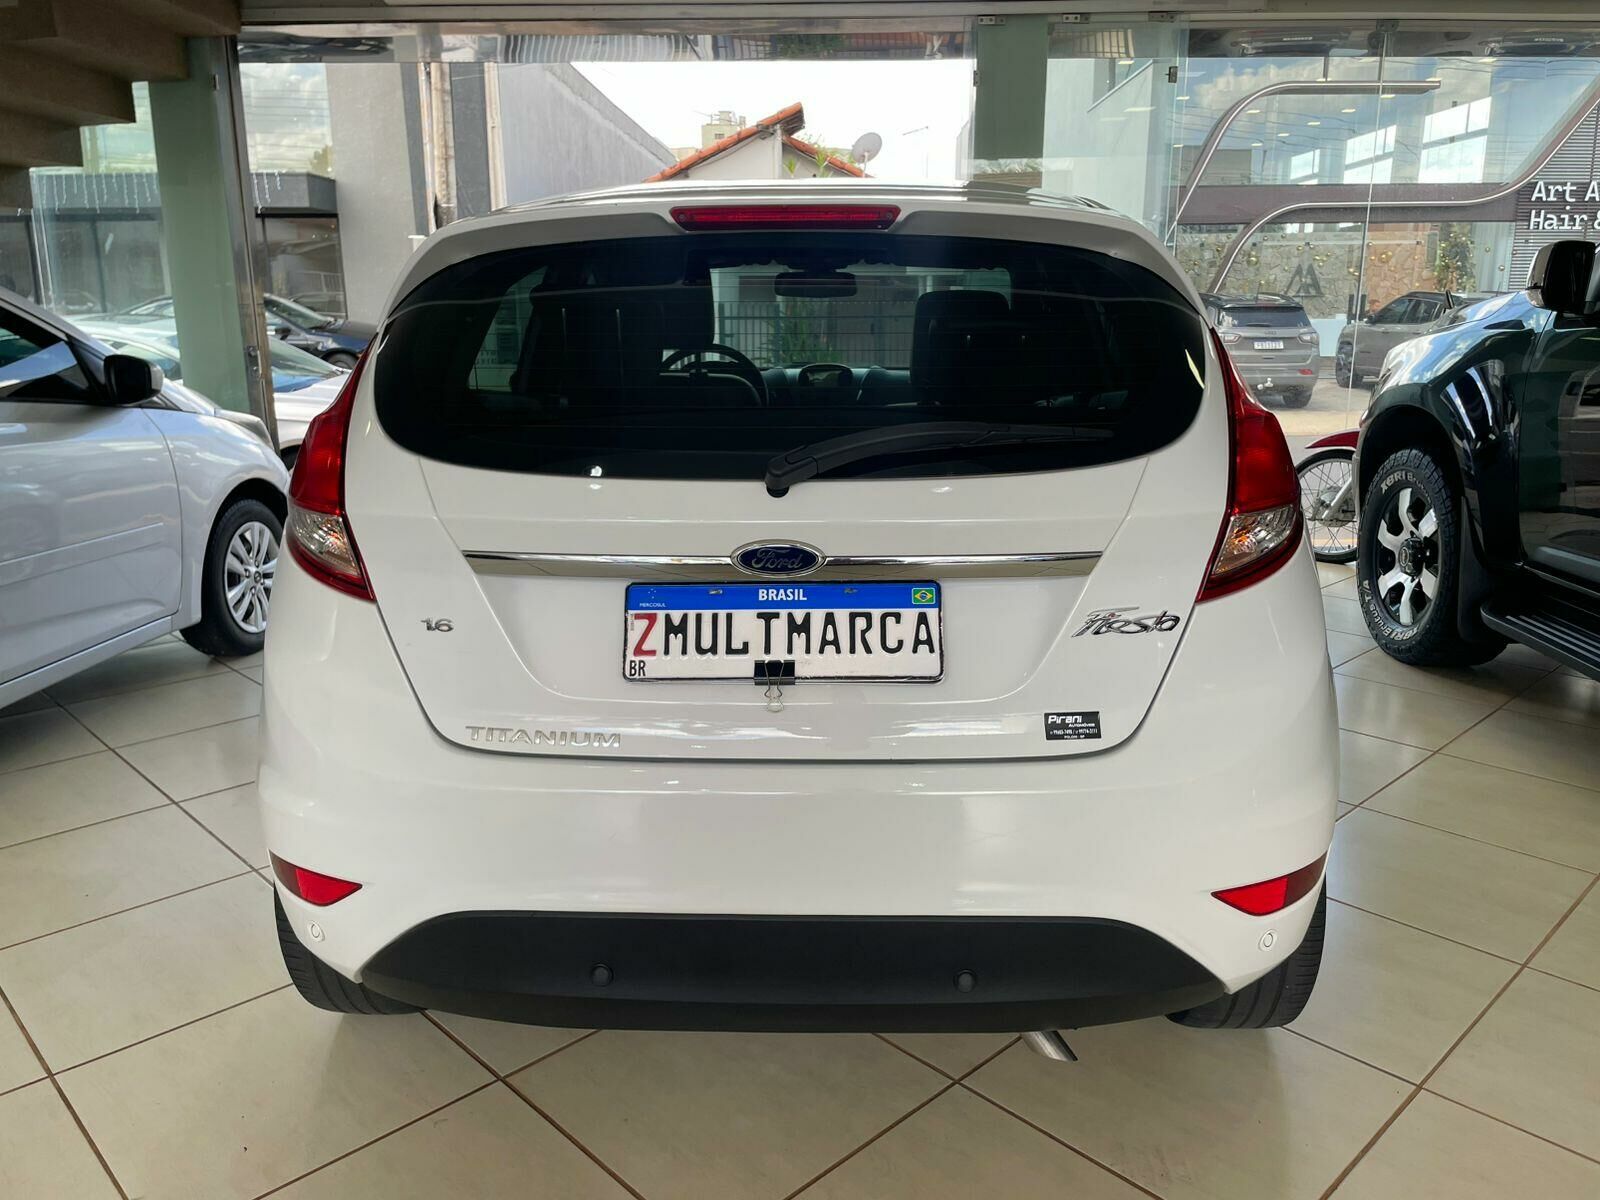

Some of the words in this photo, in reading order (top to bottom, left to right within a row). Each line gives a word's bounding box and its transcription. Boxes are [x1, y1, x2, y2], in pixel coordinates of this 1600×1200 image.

[1531, 181, 1576, 202] Art
[1529, 205, 1588, 230] Hair
[751, 548, 803, 569] Ford
[758, 588, 808, 601] BRASIL
[1071, 606, 1181, 638] Fiesta
[1369, 603, 1393, 637] Brutus
[629, 660, 646, 677] BR
[1047, 715, 1083, 724] Pirani
[465, 725, 622, 749] TITANIUM
